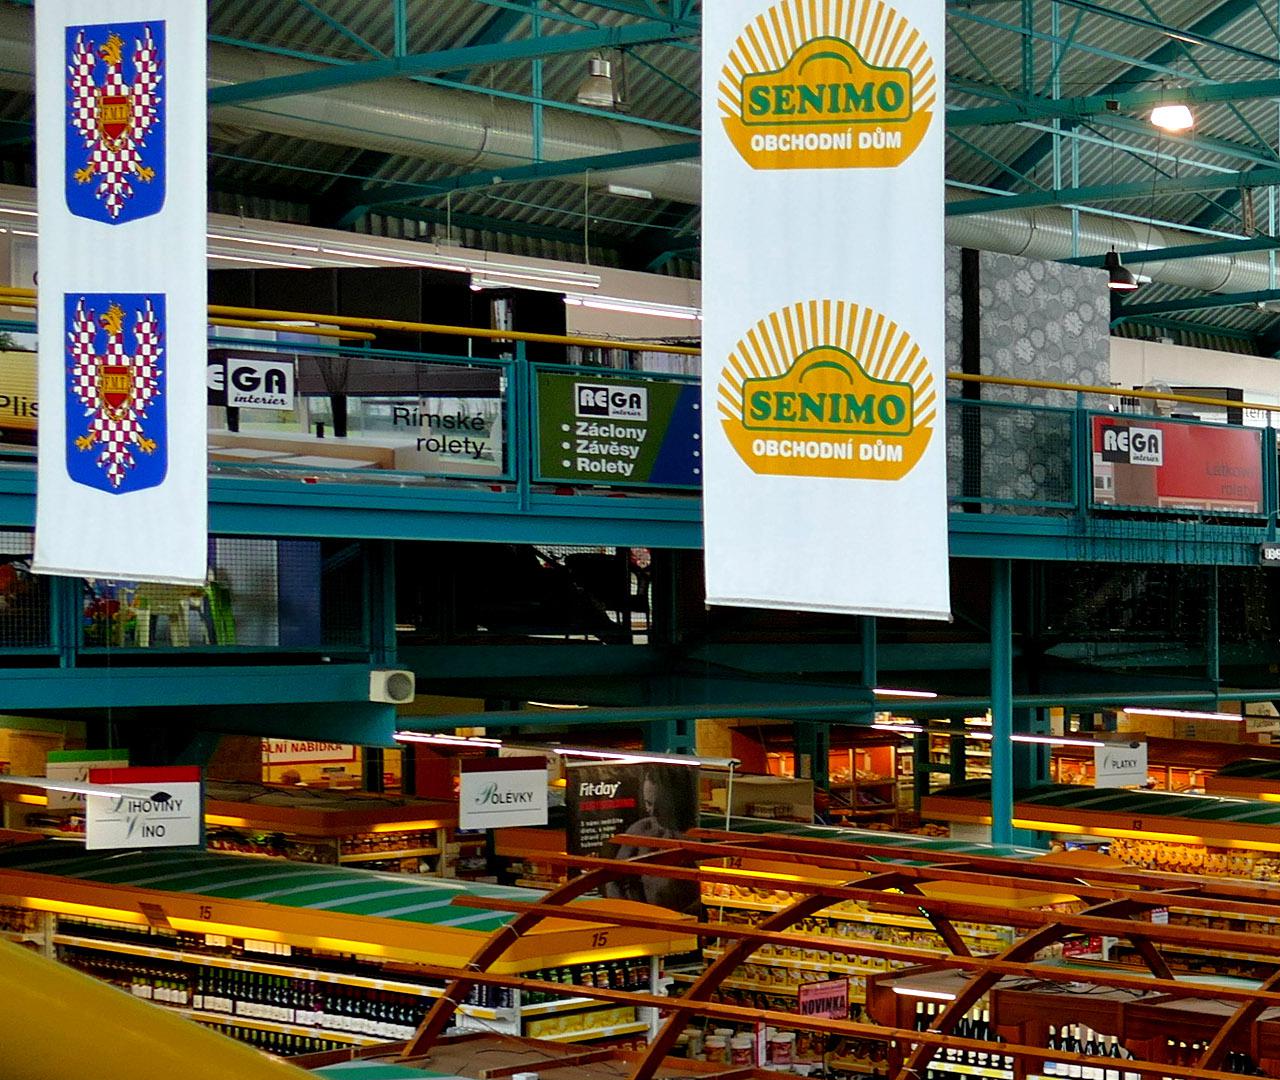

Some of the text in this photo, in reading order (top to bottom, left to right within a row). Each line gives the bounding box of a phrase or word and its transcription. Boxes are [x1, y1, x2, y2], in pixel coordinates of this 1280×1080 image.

[749, 81, 904, 115] SENIMO
[751, 127, 902, 151] OBCHODNÍ DŮM
[580, 389, 641, 409] REGA
[751, 391, 905, 425] SENIMO
[576, 422, 647, 442] Záclony
[1104, 429, 1159, 452] REGA
[417, 435, 485, 459] rolety
[576, 440, 641, 459] Závěsy
[753, 439, 902, 461] OBCHODNÍ DŮM
[577, 458, 634, 477] Rolety
[475, 782, 533, 805] POLÉVKY
[200, 906, 211, 919] 15
[592, 932, 609, 947] 15
